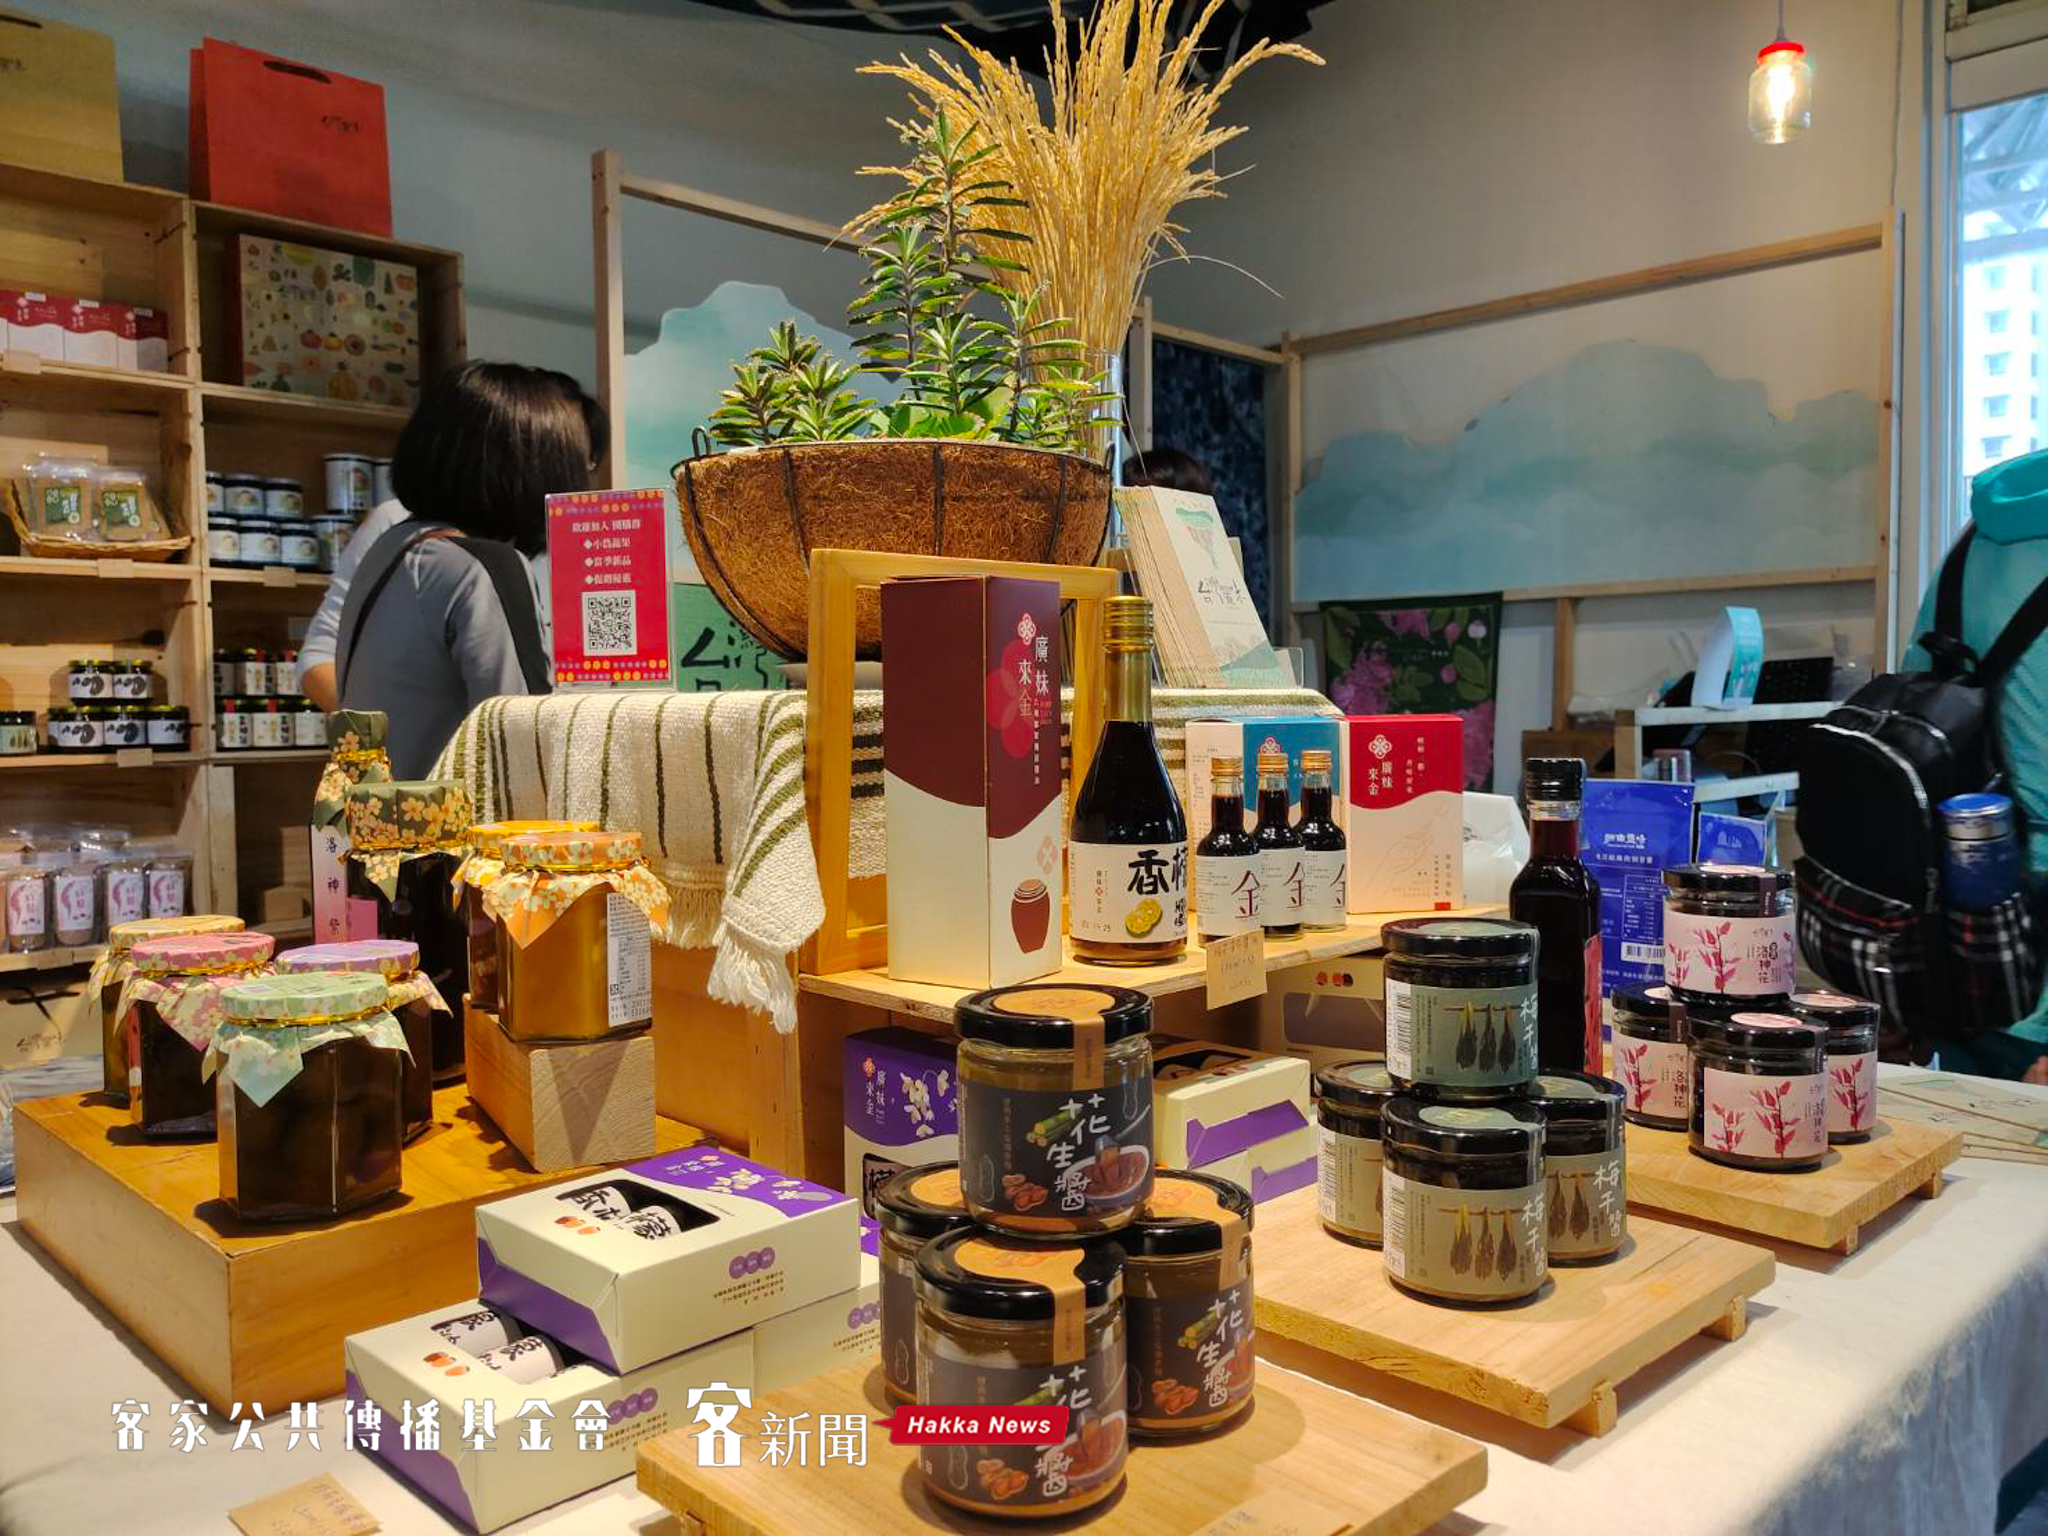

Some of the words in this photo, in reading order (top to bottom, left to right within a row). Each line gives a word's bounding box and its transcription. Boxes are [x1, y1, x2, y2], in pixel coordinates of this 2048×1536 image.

[1230, 868, 1260, 920] 金
[1046, 1092, 1111, 1212] 花生醬
[1196, 1288, 1244, 1408] 花生醬
